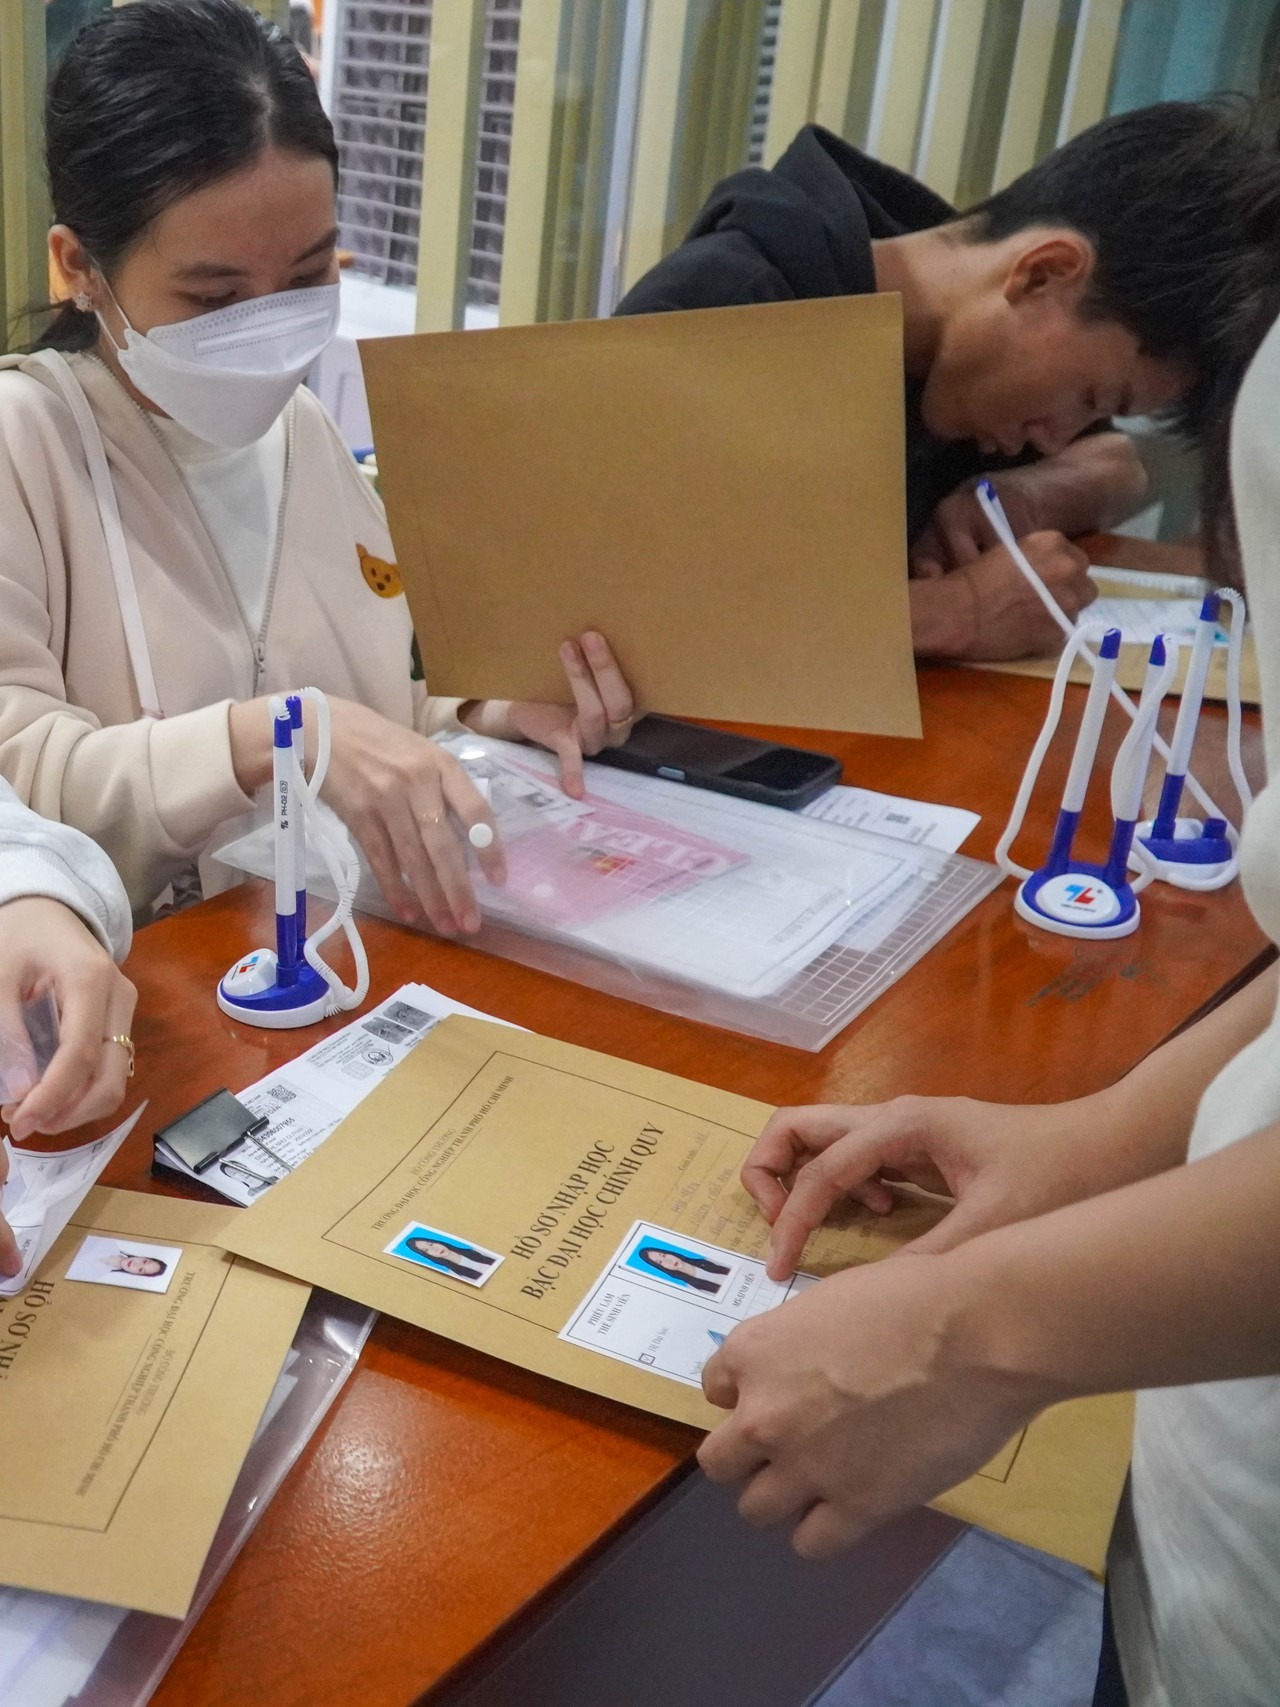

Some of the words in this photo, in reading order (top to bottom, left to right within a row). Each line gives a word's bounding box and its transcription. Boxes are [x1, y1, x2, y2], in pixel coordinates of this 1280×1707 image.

[510, 1235, 542, 1260] HỒ
[530, 1212, 559, 1236] SƠ
[546, 1173, 589, 1216] NHẬP
[578, 1140, 615, 1175] HỌC
[520, 1266, 560, 1300] BẬC
[547, 1238, 583, 1268] ĐẠI
[569, 1204, 608, 1241] HỌC
[595, 1156, 643, 1205] CHÍNH
[630, 1121, 665, 1157] QUY
[8, 1311, 37, 1340] SƠ
[23, 1280, 55, 1308] HỒ
